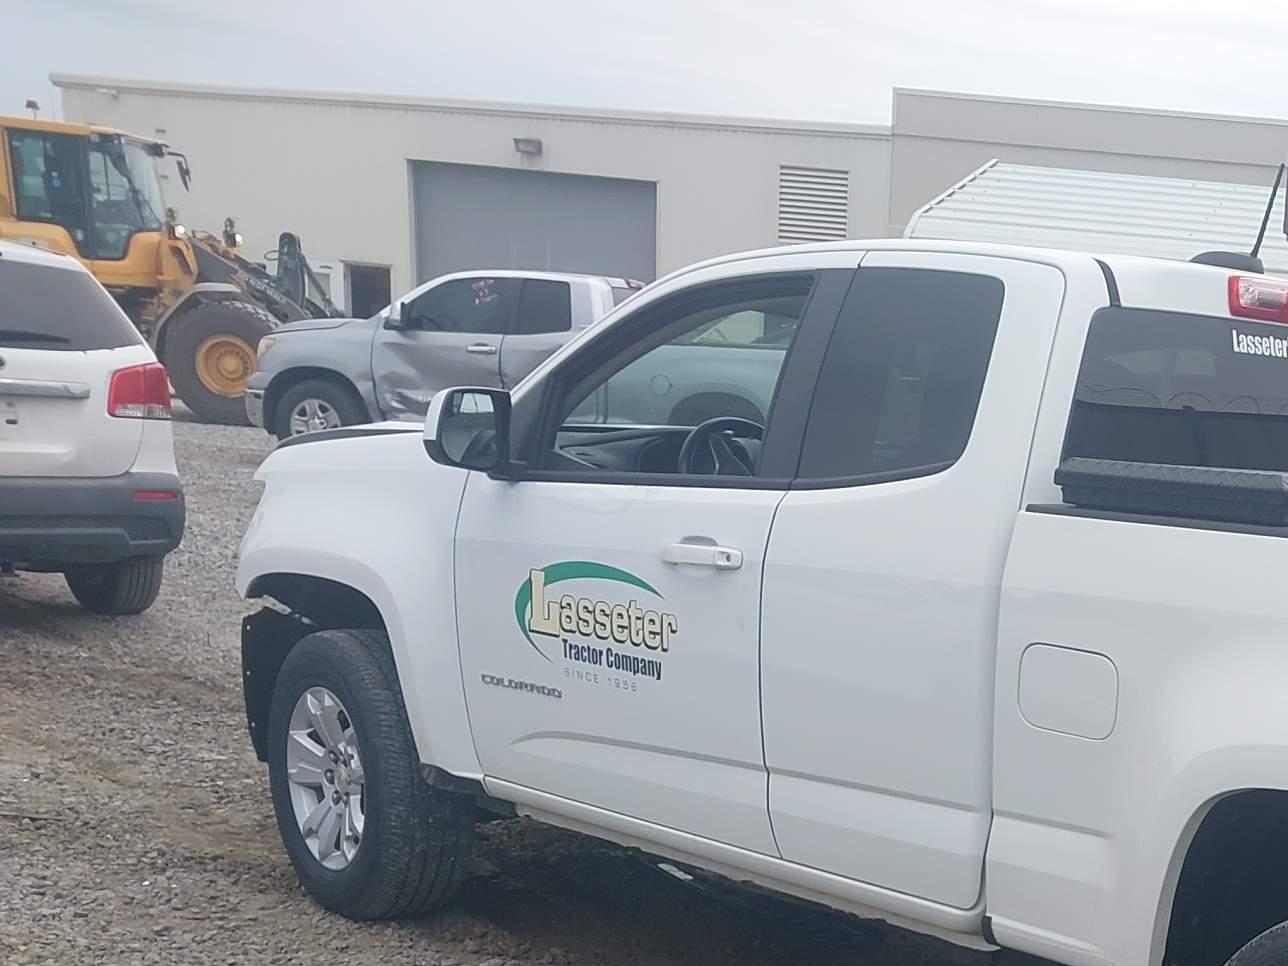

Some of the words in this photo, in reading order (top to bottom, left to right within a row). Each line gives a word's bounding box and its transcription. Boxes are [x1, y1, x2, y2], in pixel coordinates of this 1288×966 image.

[529, 568, 678, 652] Lasseter
[562, 639, 603, 666] Tractor
[606, 647, 662, 681] Company
[564, 667, 599, 684] SINCE
[481, 674, 562, 699] COLORADO
